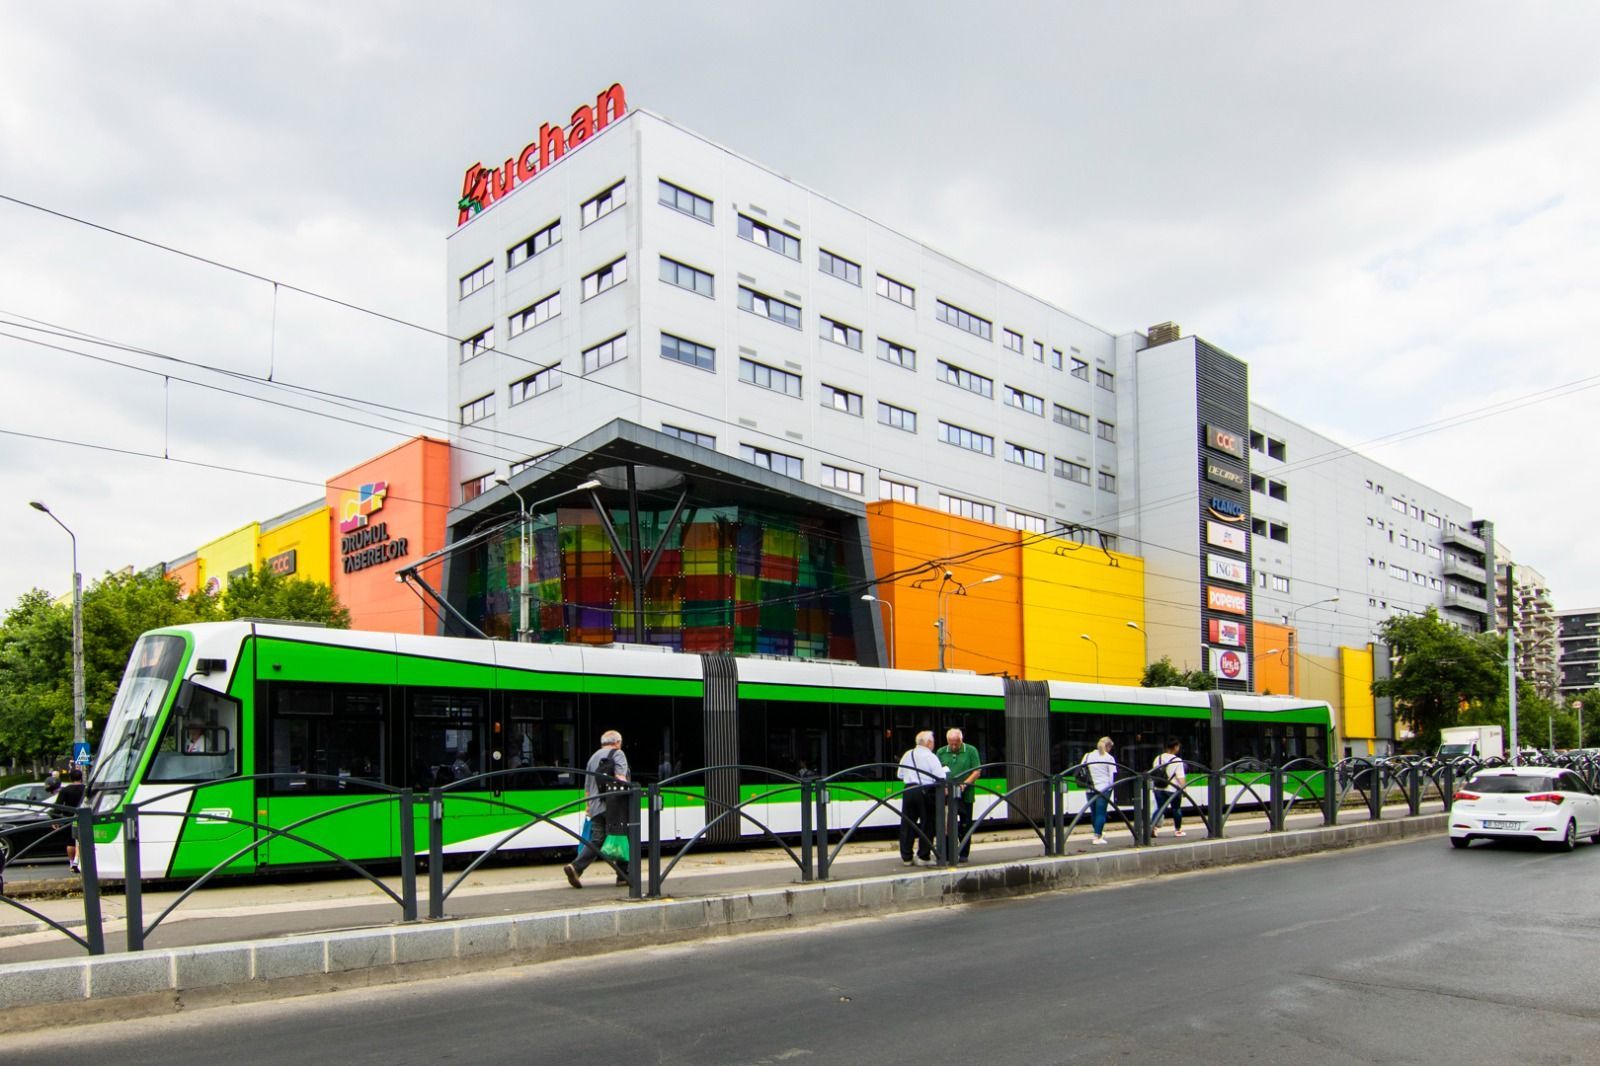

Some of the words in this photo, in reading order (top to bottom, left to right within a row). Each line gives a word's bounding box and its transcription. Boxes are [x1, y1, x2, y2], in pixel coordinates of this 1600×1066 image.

[458, 82, 625, 227] Auchan
[1217, 433, 1236, 451] CCC
[1211, 496, 1243, 517] FLANCO
[341, 521, 389, 555] DRUMUL
[272, 556, 288, 573] CCC
[341, 538, 408, 575] TABERELOR
[1216, 562, 1231, 577] ING
[1209, 590, 1246, 611] POPEYES
